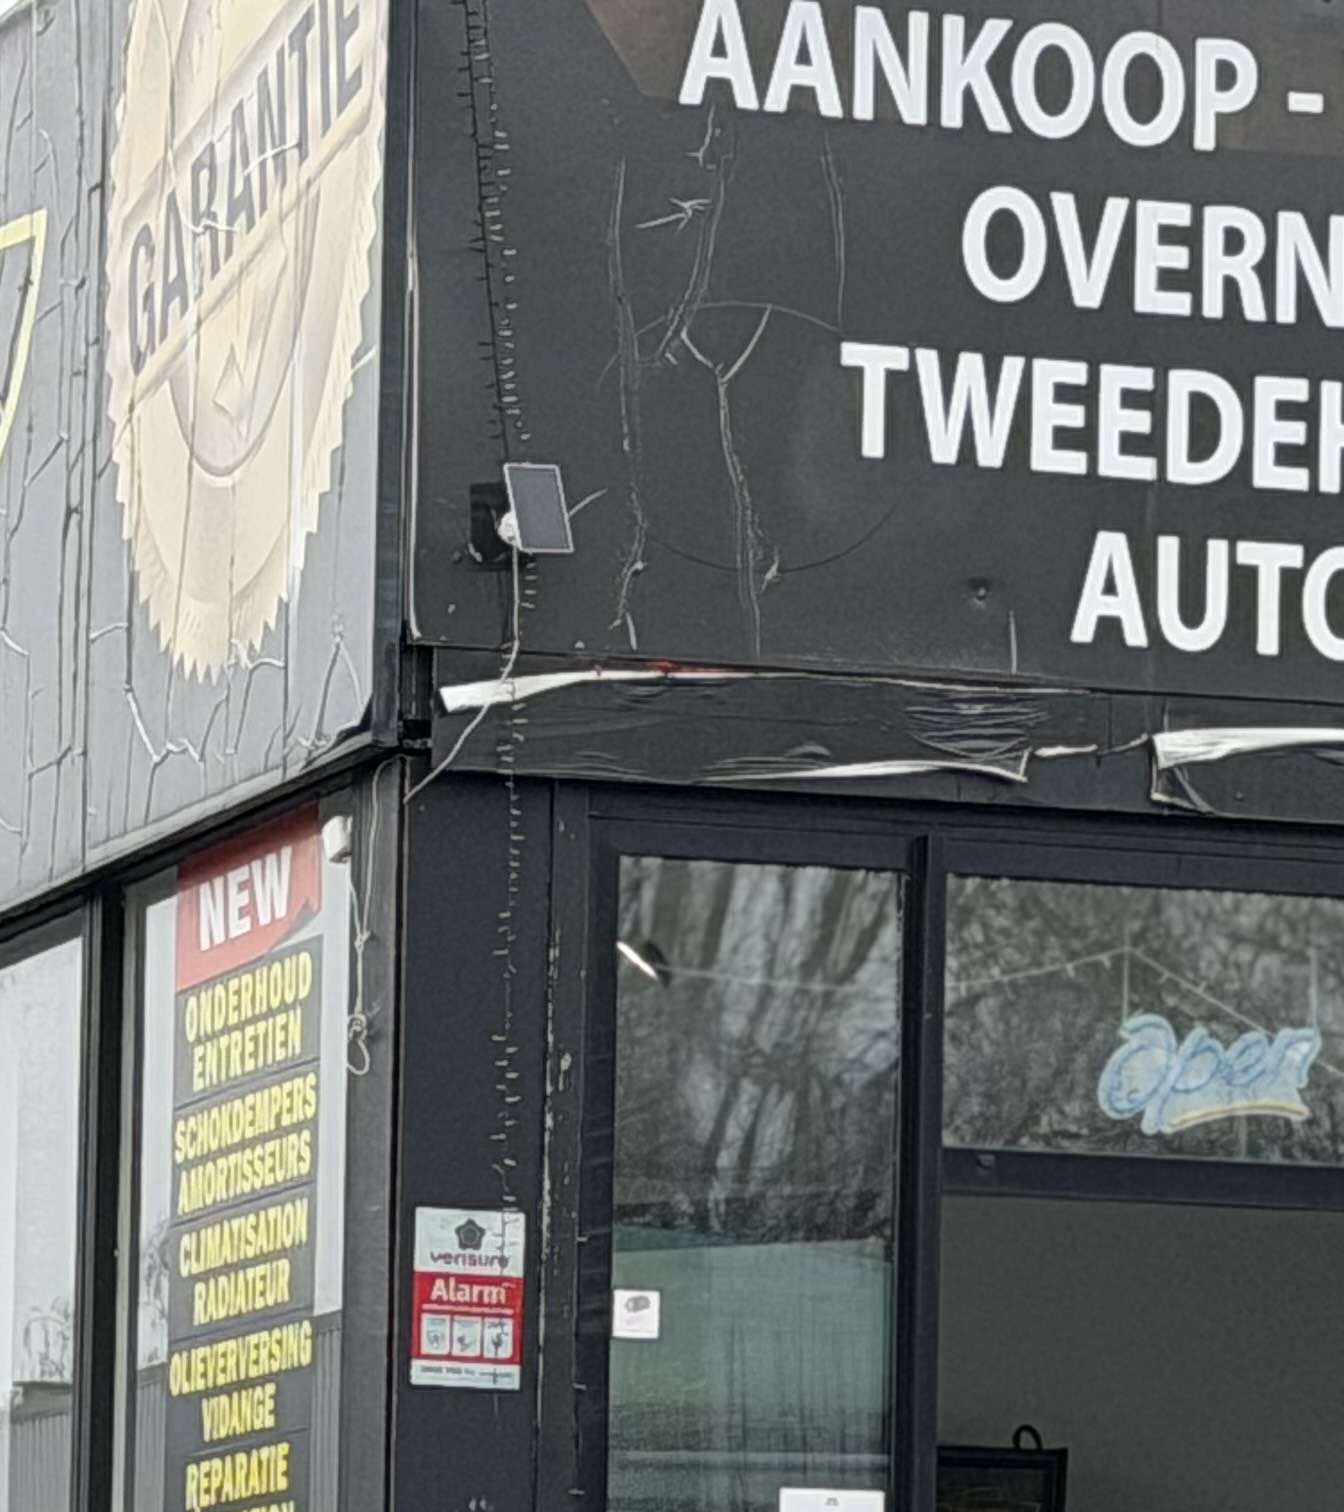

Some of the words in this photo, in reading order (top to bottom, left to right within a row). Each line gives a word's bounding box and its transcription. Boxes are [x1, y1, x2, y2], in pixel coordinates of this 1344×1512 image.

[679, 0, 1256, 151] AANKOOP
[128, 0, 362, 376] GARANTIE
[199, 846, 293, 951] NEW
[185, 951, 312, 1043] ONDERHOUD
[193, 1004, 302, 1093] ENTRETIEN
[1098, 1014, 1321, 1134] Open
[175, 1071, 317, 1164] SCHOKDEMPERS
[177, 1129, 312, 1216] AMORTISSEURS
[180, 1197, 309, 1278] CLIMATISATION
[193, 1258, 291, 1326] RADIATEUR
[431, 1278, 506, 1305] Alarm
[169, 1319, 313, 1397] OLIEVERVERSING
[201, 1382, 276, 1442] VIDANGE
[185, 1442, 290, 1512] REPARATIE
